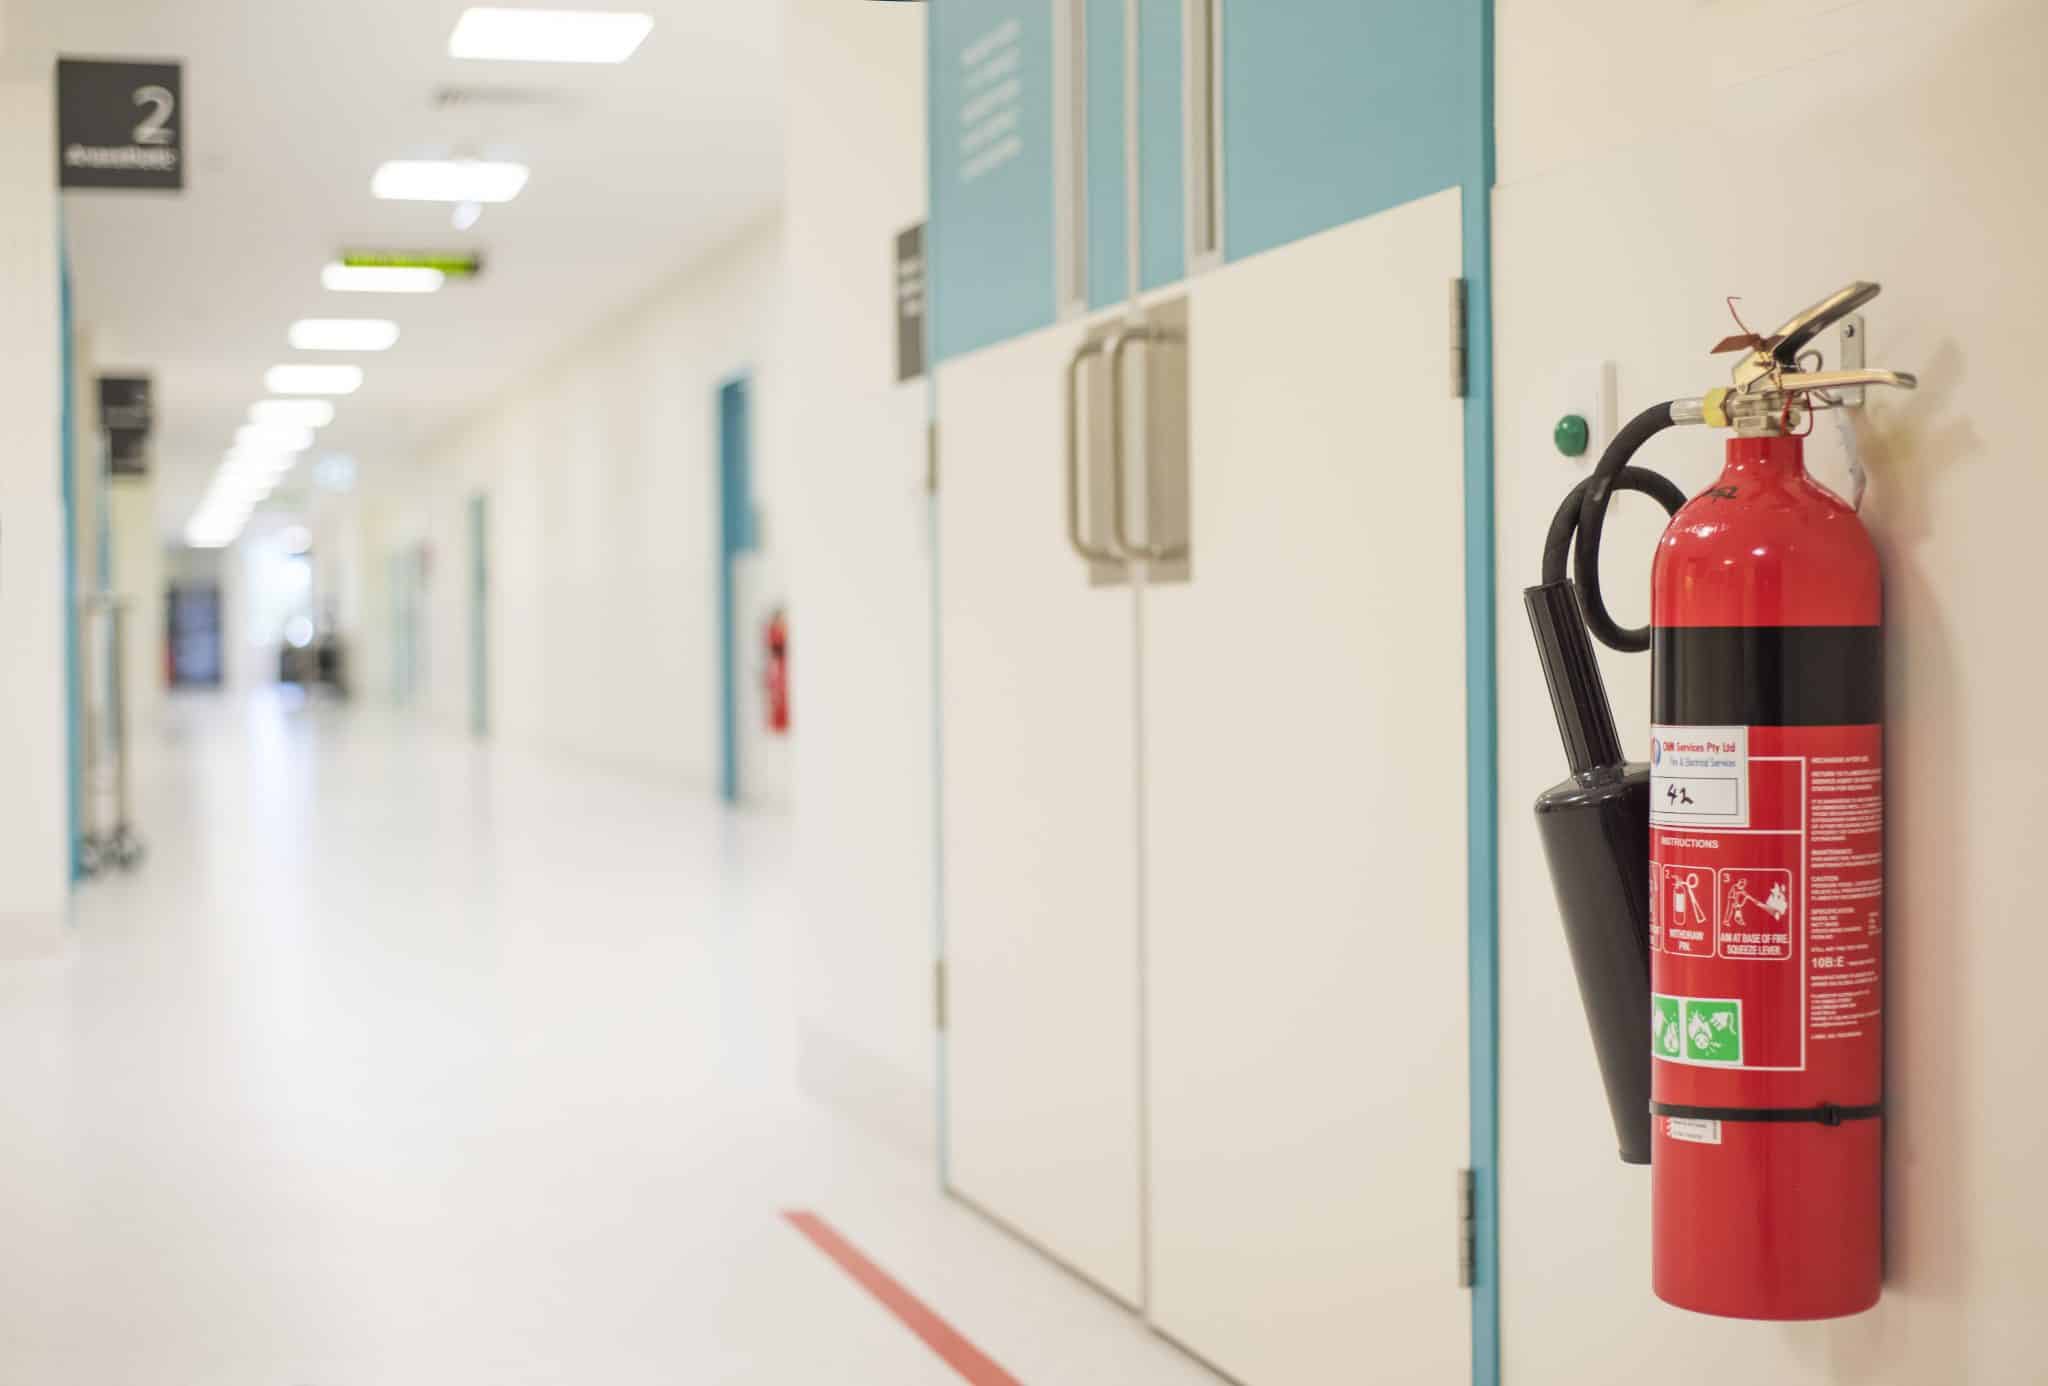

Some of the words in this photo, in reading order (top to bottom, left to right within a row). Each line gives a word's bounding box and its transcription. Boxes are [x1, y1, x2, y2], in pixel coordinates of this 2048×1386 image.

[132, 85, 175, 144] 2
[1706, 741, 1720, 755] Pty
[1723, 741, 1736, 753] Ltd
[1666, 783, 1695, 807] 42
[1723, 872, 1731, 883] 3
[1742, 933, 1761, 943] BASE
[1762, 933, 1772, 943] OF
[1811, 955, 1845, 969] 10B:E
